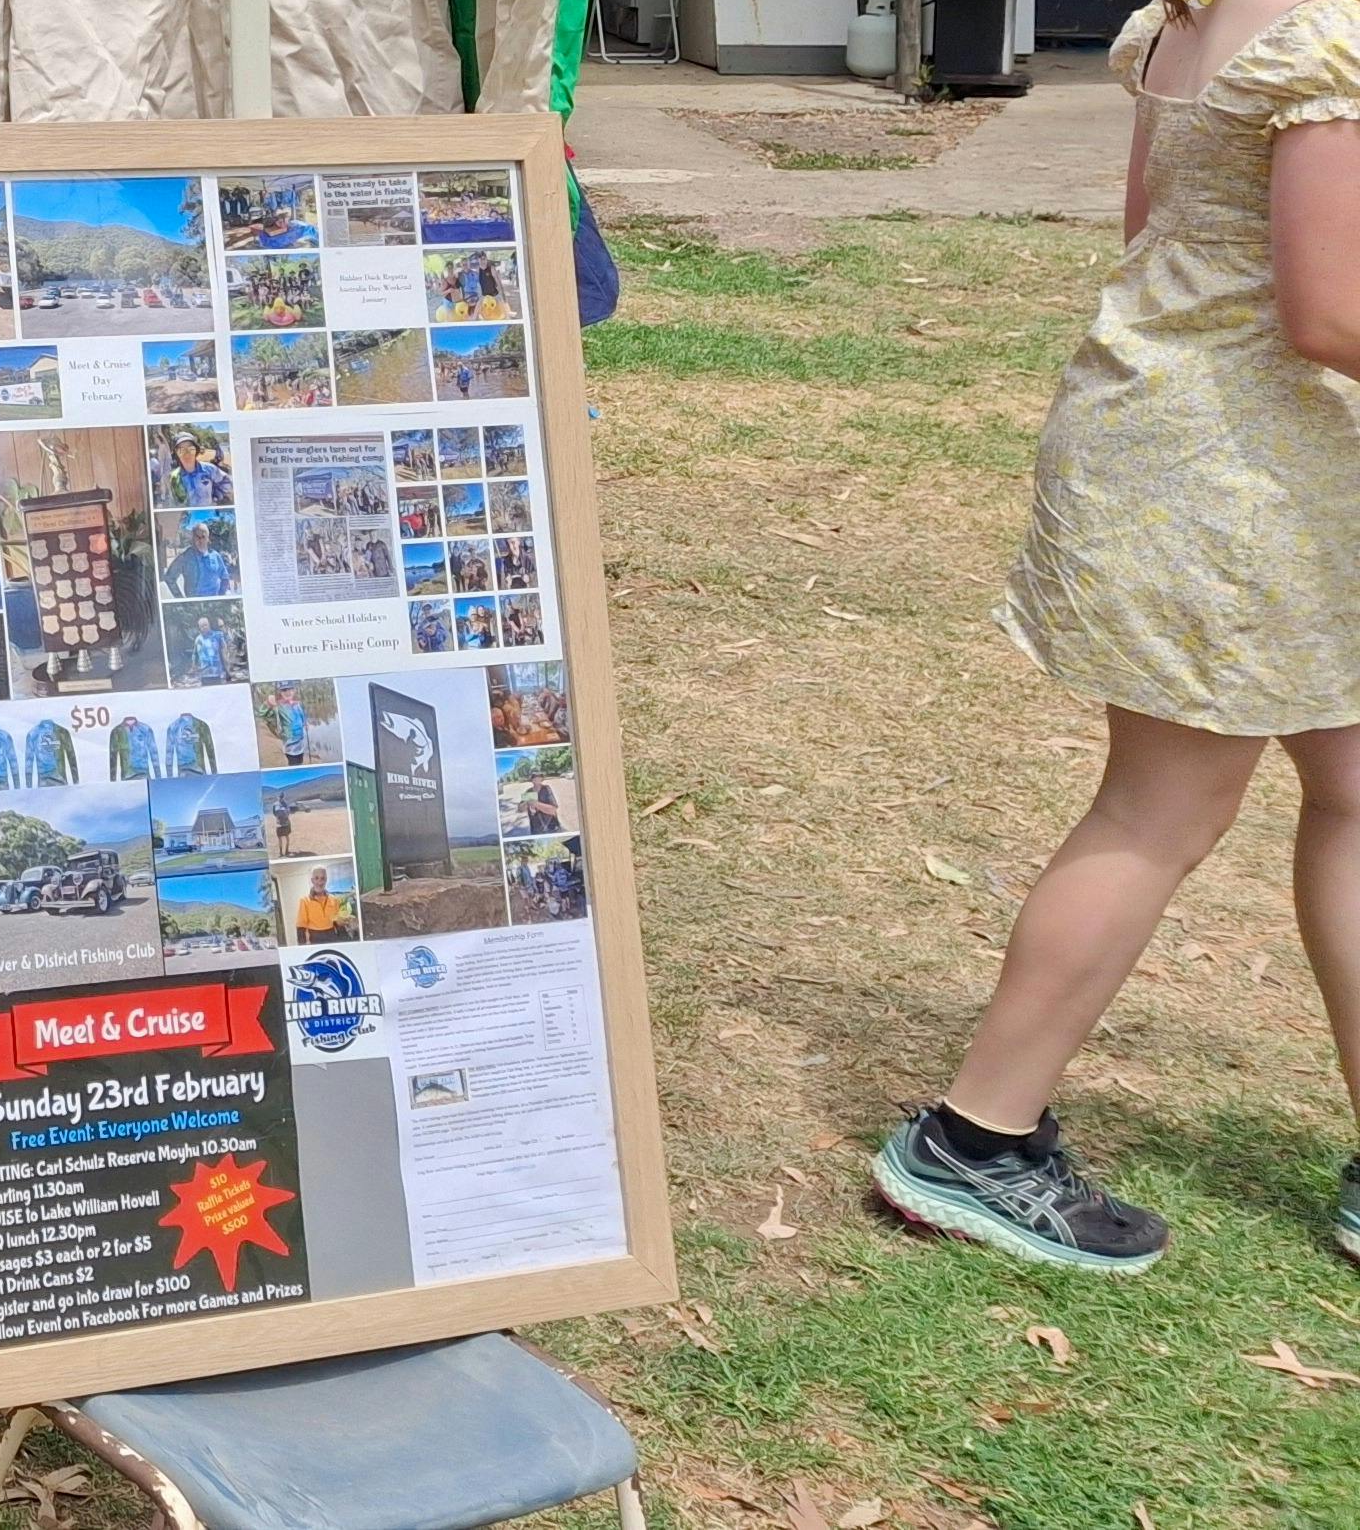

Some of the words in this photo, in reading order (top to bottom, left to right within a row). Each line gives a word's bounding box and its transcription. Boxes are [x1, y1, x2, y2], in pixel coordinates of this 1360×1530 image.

[68, 360, 90, 370] Meet
[103, 359, 132, 369] Cruise
[93, 375, 112, 386] Day
[81, 391, 123, 402] February
[258, 455, 278, 465] King
[281, 455, 303, 464] River
[331, 454, 360, 464] fishing
[281, 618, 313, 628] Winter
[315, 614, 345, 625] School
[347, 613, 387, 625] Holidays
[273, 642, 318, 655] Futures
[321, 638, 364, 653] Fishing
[366, 636, 399, 651] Comp
[71, 705, 109, 732] $50
[483, 932, 526, 945] Membership
[526, 930, 544, 940] Form
[21, 954, 31, 970] &
[34, 949, 78, 969] District
[81, 948, 123, 965] Fishing
[126, 942, 155, 959] Club
[327, 996, 381, 1015] RIVER
[34, 1014, 95, 1050] Meet
[101, 1011, 121, 1041] &
[127, 1007, 205, 1038] Cruise
[314, 1017, 357, 1028] DISTRICT
[301, 1030, 346, 1048] Fishing
[349, 1023, 377, 1037] Club
[87, 1076, 149, 1111] 23rd
[154, 1069, 265, 1103] February
[10, 1130, 46, 1151] Free
[48, 1124, 95, 1147] Event:
[98, 1115, 169, 1142] Everyone
[171, 1109, 240, 1130] Welcome
[36, 1157, 63, 1177] Carl
[65, 1153, 105, 1173] Schulz
[107, 1149, 156, 1168] Reserve
[157, 1142, 200, 1164] Moyhu
[202, 1137, 257, 1156] 10.30am
[32, 1181, 84, 1199] 11.30am
[209, 1173, 228, 1189] $10
[26, 1207, 38, 1223] to
[40, 1203, 71, 1221] Lake
[72, 1198, 118, 1217] William
[120, 1190, 160, 1210] Hovell
[196, 1195, 223, 1214] Raffle
[222, 1179, 252, 1200] Tickets
[203, 1208, 228, 1227] Prize
[228, 1194, 256, 1215] valued
[6, 1229, 40, 1249] lunch
[41, 1224, 97, 1244] 12.30pm
[221, 1214, 249, 1235] $500
[35, 1249, 54, 1268] $3
[55, 1245, 85, 1264] each
[86, 1247, 100, 1260] or
[101, 1241, 112, 1257] 2
[113, 1238, 132, 1256] for
[134, 1235, 152, 1253] $5
[6, 1274, 42, 1294] Drink
[42, 1271, 74, 1288] Cans
[75, 1266, 95, 1284] $2
[32, 1294, 56, 1313] and
[58, 1297, 74, 1313] go
[76, 1290, 100, 1306] into
[102, 1285, 133, 1303] draw
[135, 1280, 155, 1299] for
[156, 1274, 191, 1295] $100
[27, 1315, 62, 1336] Event
[63, 1316, 81, 1330] on
[82, 1304, 140, 1328] Facebook
[141, 1302, 164, 1319] For
[165, 1300, 197, 1315] more
[198, 1293, 240, 1310] Games
[241, 1285, 264, 1304] and
[265, 1283, 304, 1301] Prizes
